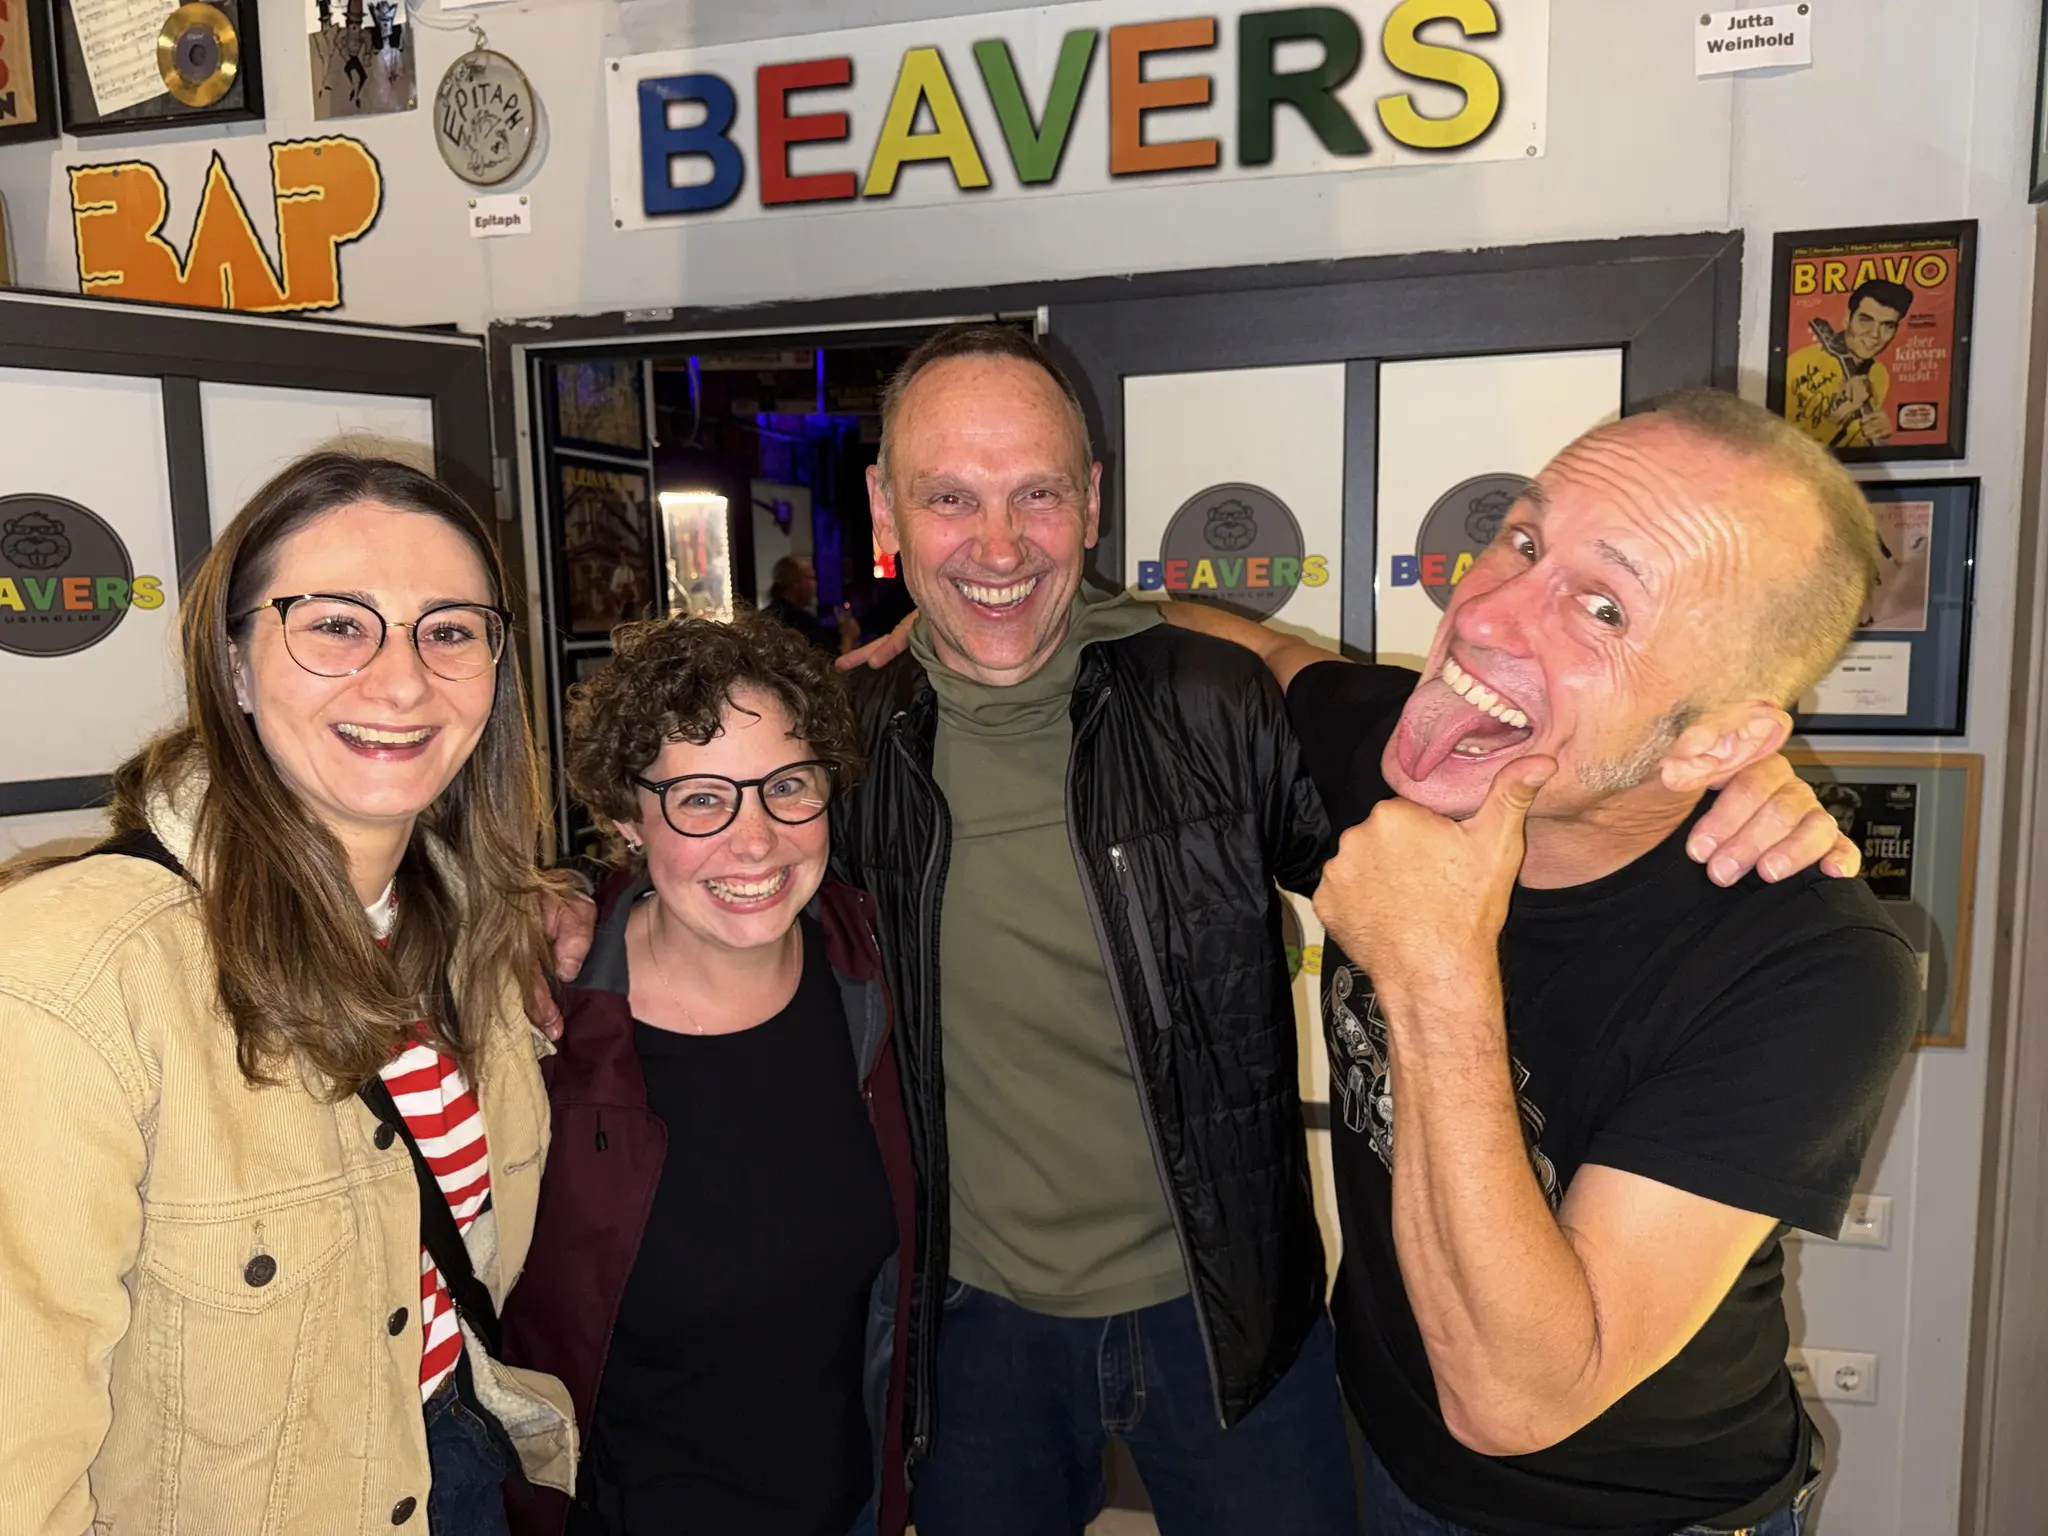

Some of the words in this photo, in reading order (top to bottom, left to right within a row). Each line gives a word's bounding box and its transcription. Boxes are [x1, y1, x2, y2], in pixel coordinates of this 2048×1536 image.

[1728, 14, 1774, 31] Jutta
[1707, 33, 1795, 54] Weinhold
[443, 83, 524, 147] EPITAPH
[638, 0, 1501, 217] BEAVERS
[66, 135, 384, 313] BAP
[475, 213, 521, 228] Epitaph
[1793, 253, 1950, 296] BRAVO
[1138, 554, 1330, 592] BEAVERS
[1864, 839, 1911, 859] STEELE
